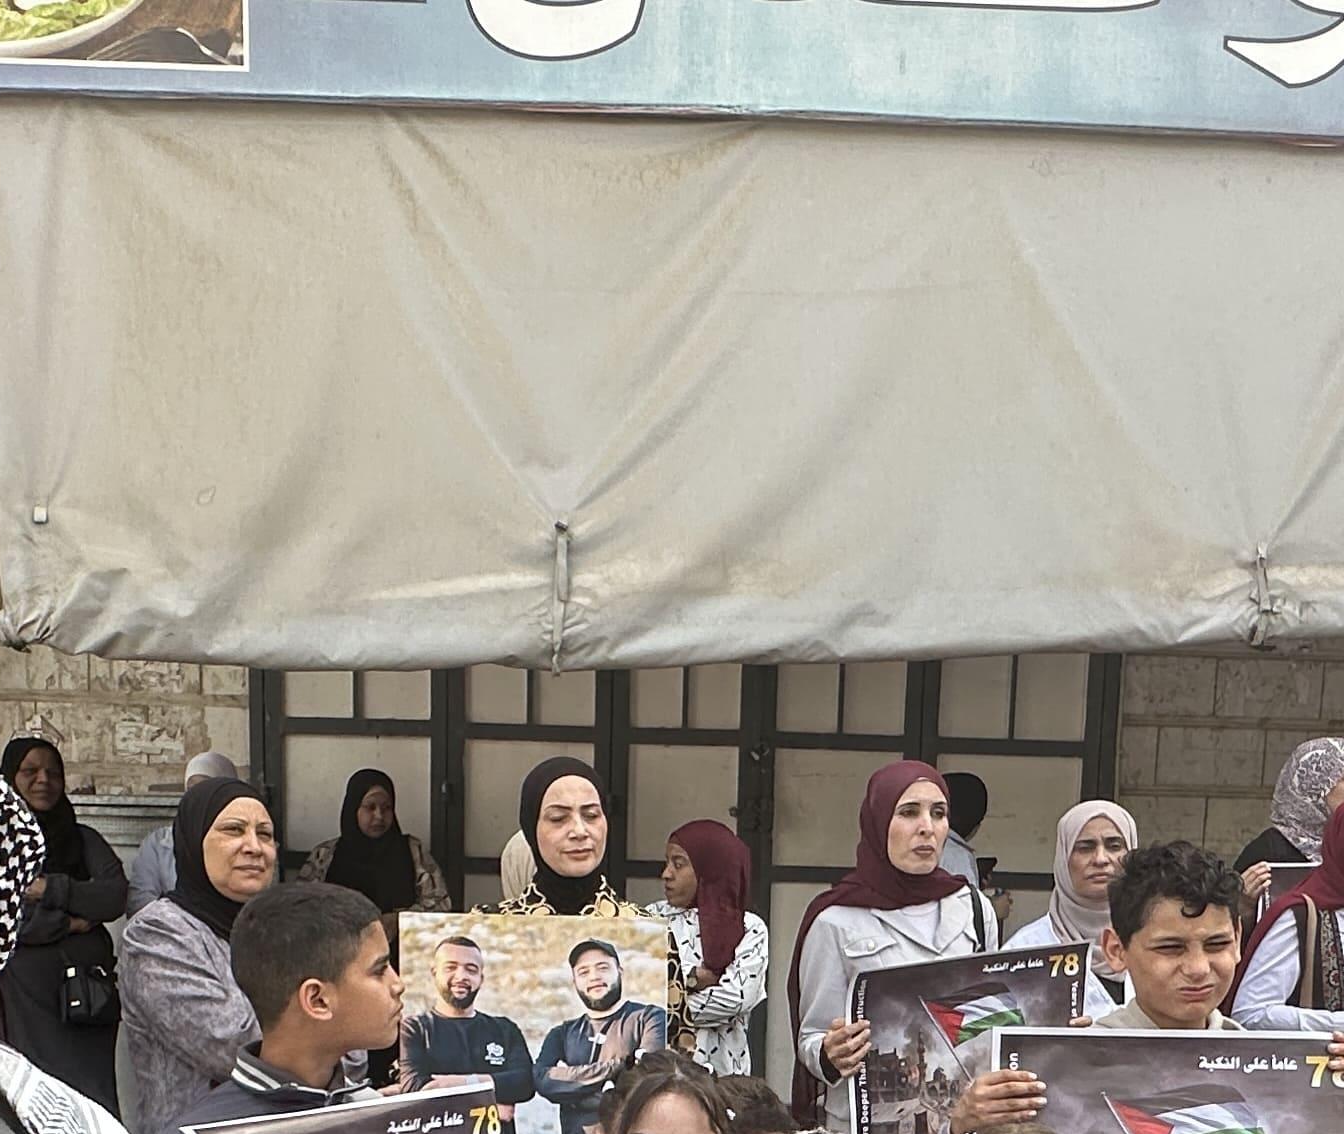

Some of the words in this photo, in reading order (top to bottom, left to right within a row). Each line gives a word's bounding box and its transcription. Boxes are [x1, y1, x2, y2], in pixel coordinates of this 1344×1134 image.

[1049, 953, 1080, 977] 78
[1198, 1055, 1241, 1073] النكبة
[1244, 1056, 1269, 1073] على
[421, 1117, 442, 1134] على
